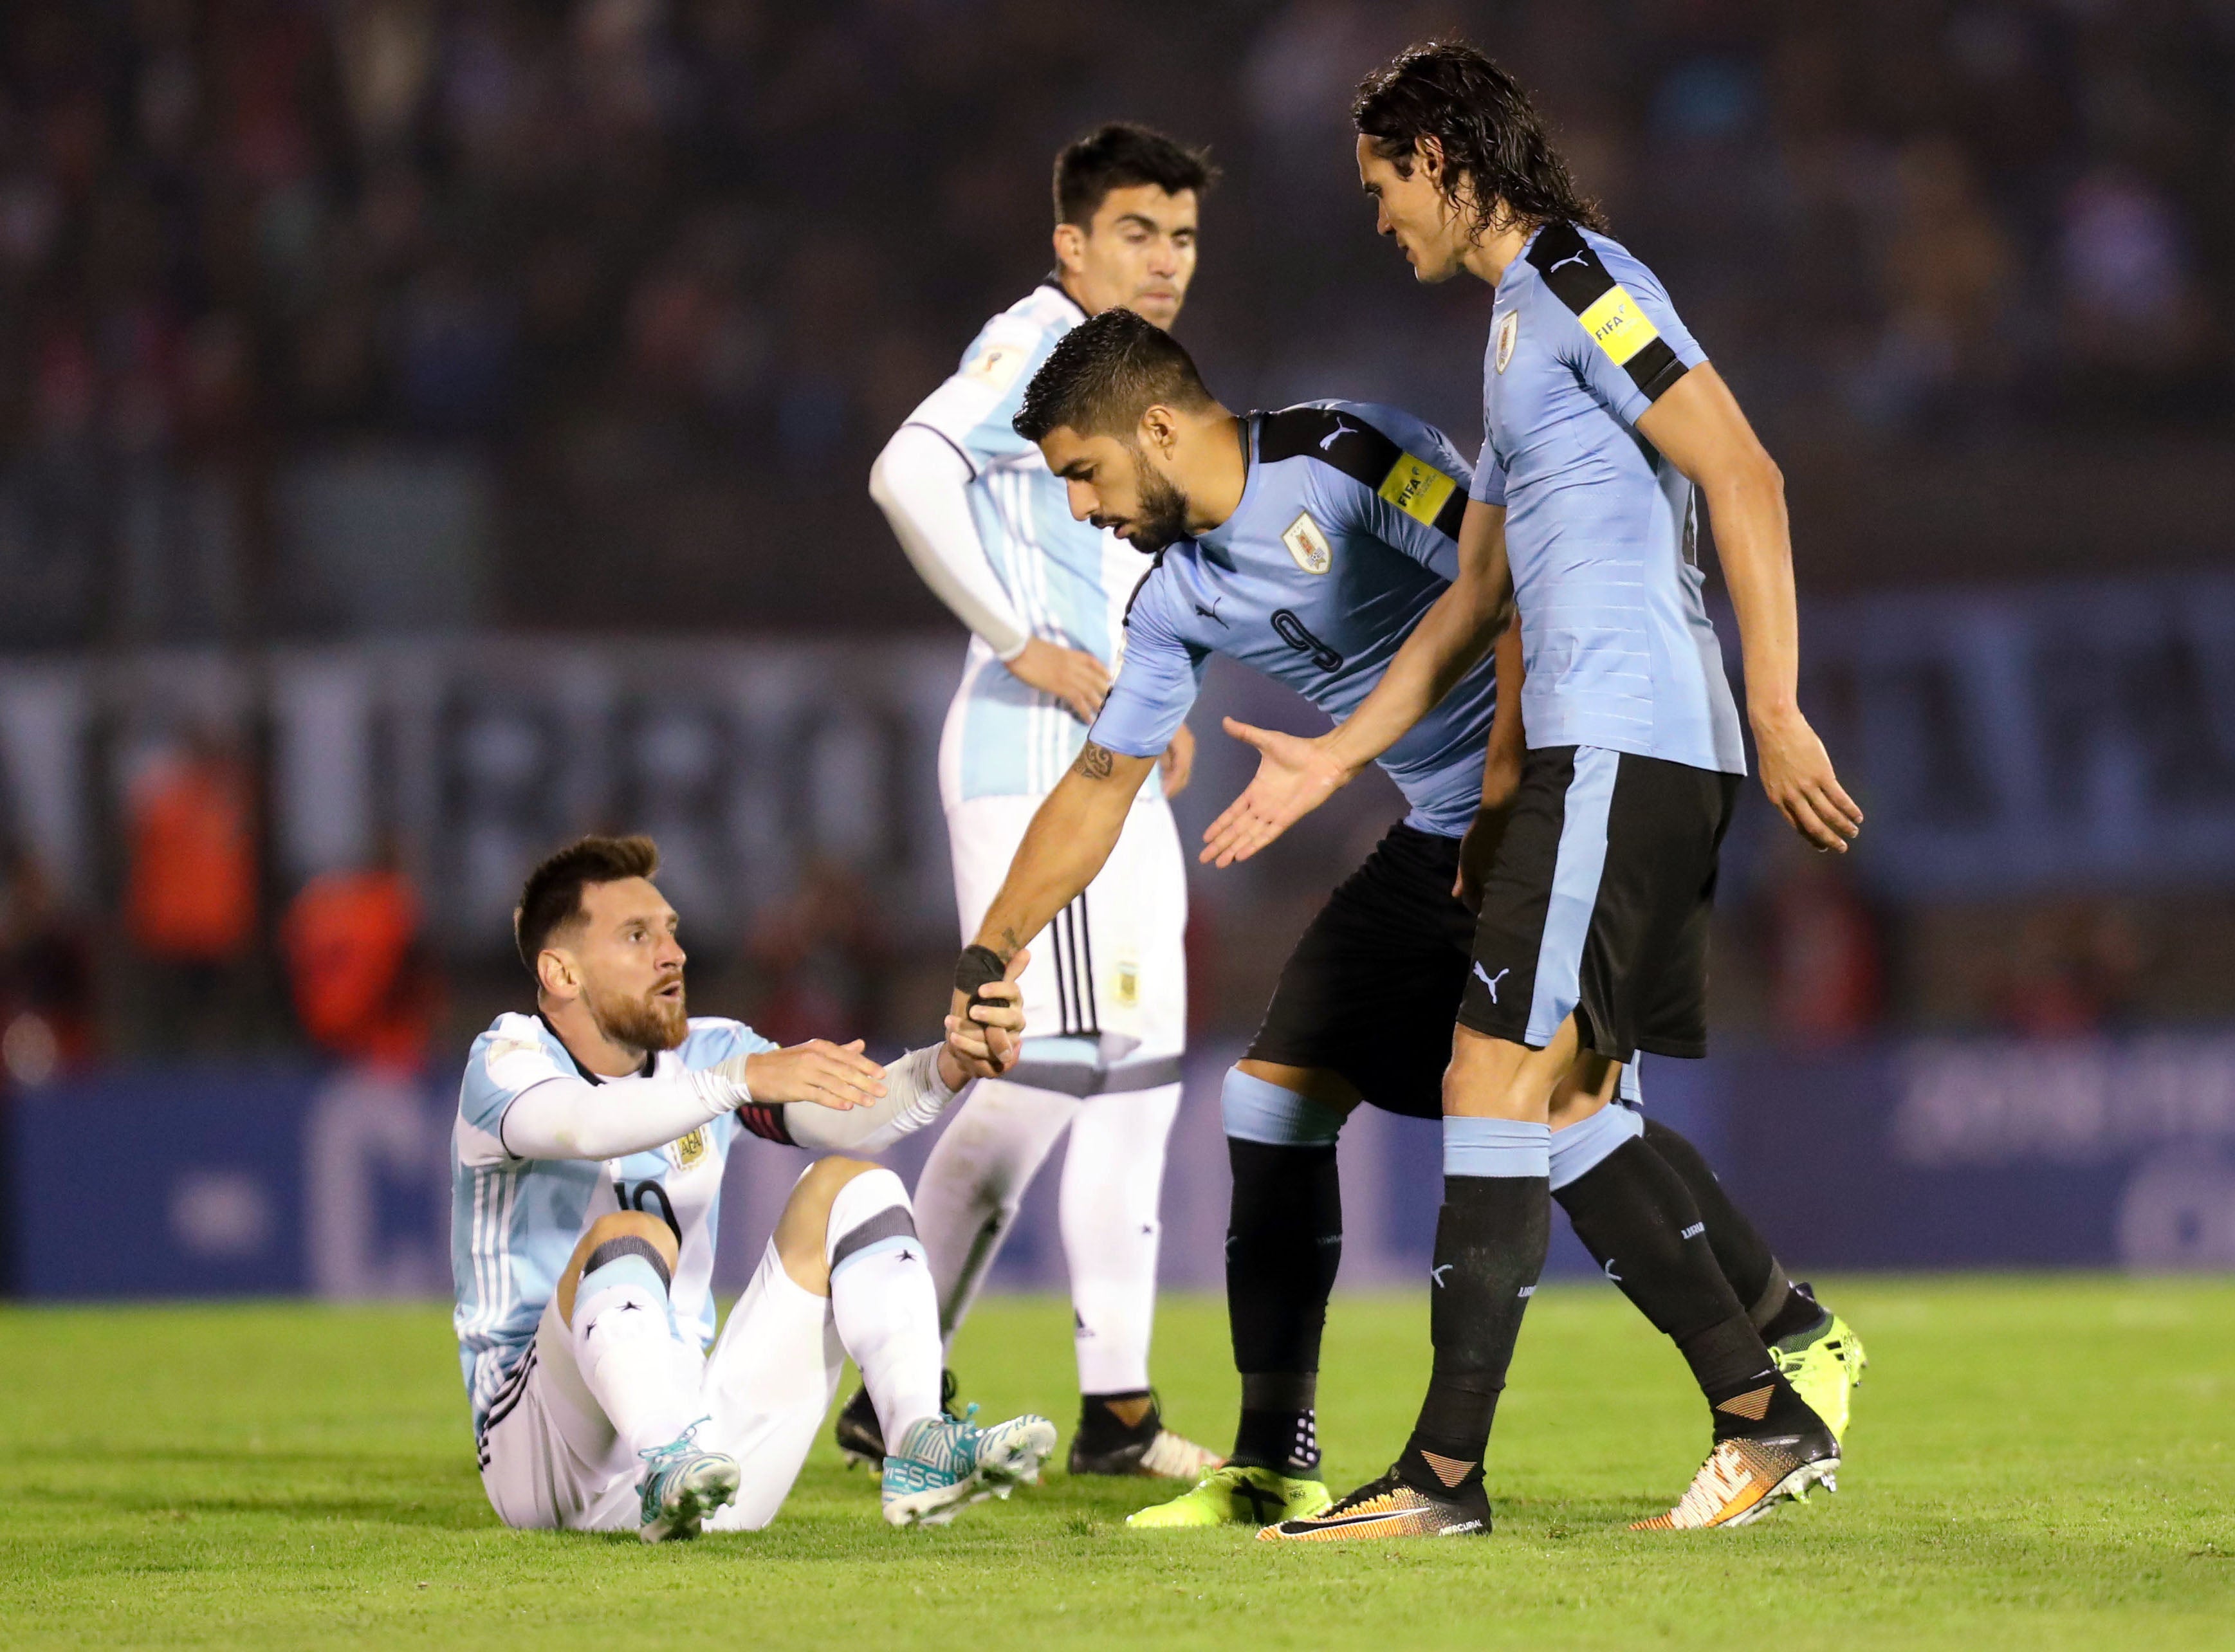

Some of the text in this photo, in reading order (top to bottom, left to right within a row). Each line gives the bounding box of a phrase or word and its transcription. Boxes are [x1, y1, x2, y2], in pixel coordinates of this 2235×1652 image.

[1595, 316, 1624, 341] FIFA
[1397, 479, 1421, 507] FIFA
[1271, 609, 1343, 673] 9
